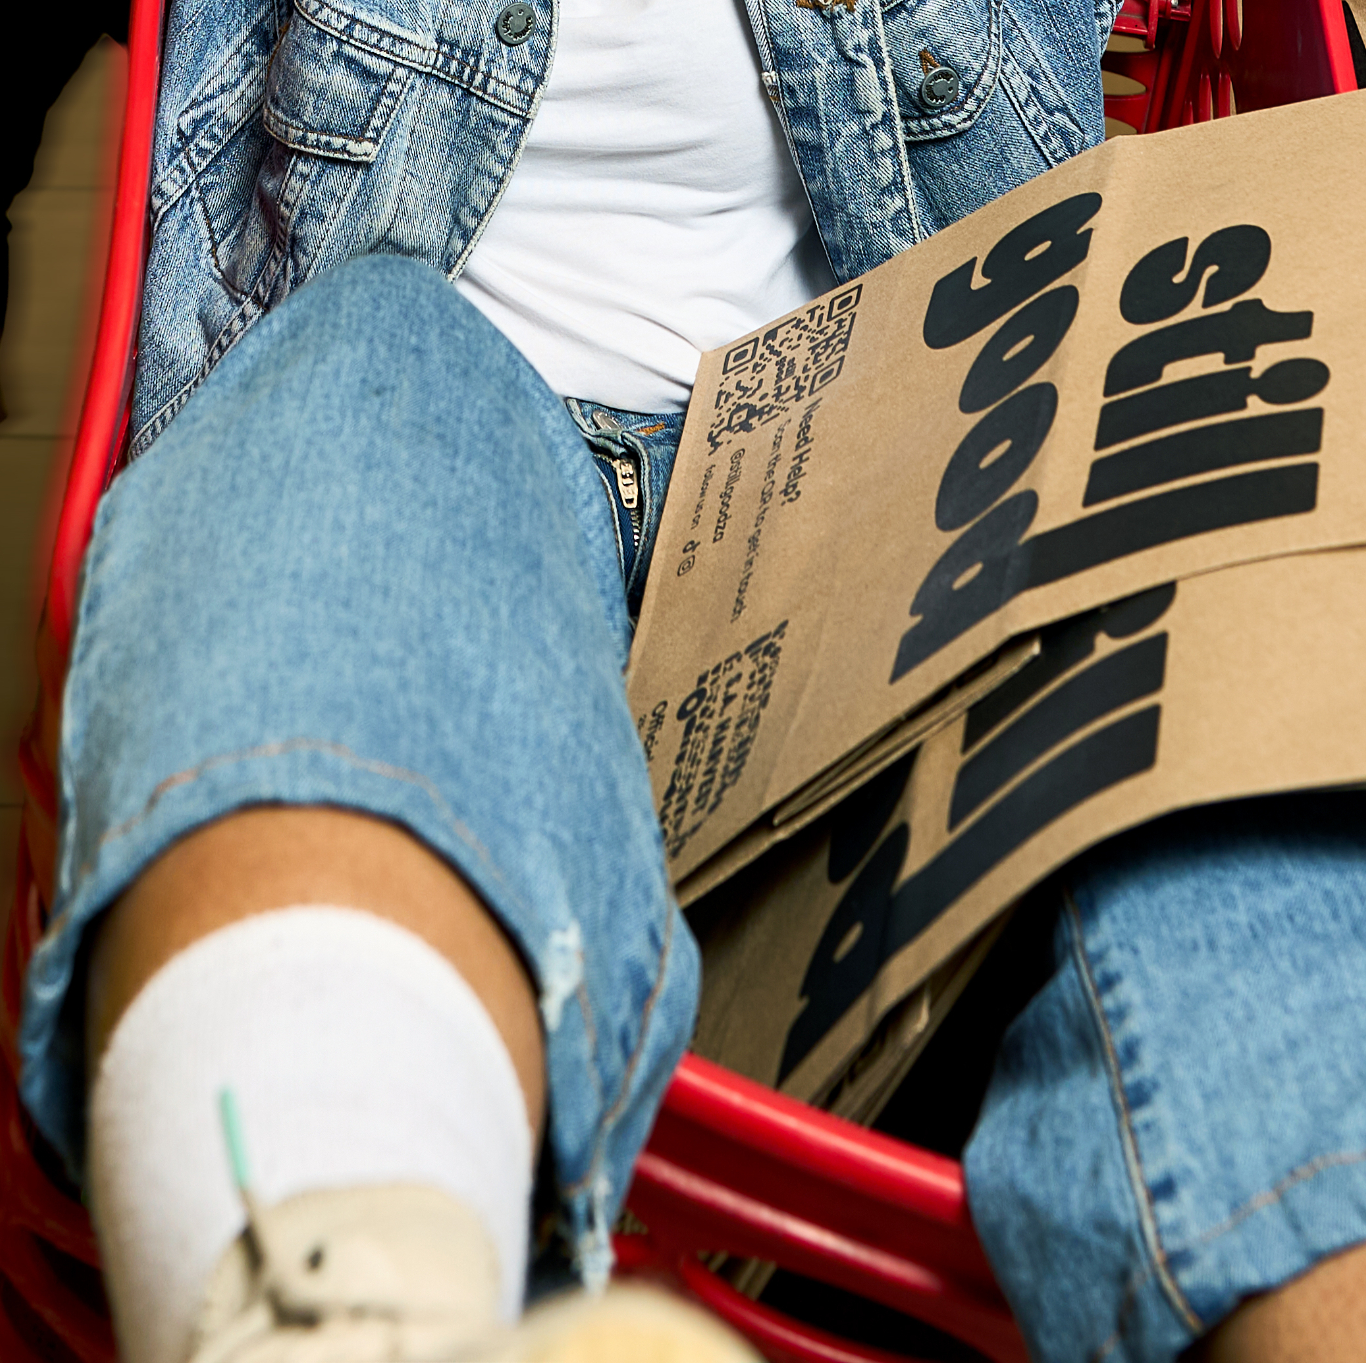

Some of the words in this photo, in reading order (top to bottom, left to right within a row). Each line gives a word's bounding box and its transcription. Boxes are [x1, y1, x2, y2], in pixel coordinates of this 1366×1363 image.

[1055, 224, 1330, 553] still
[794, 397, 823, 451] Need
[889, 192, 1103, 685] good
[712, 447, 746, 543] @stillgoodza
[759, 479, 776, 510] QR
[764, 453, 782, 482] the
[779, 447, 812, 507] Help?
[754, 505, 770, 528] to
